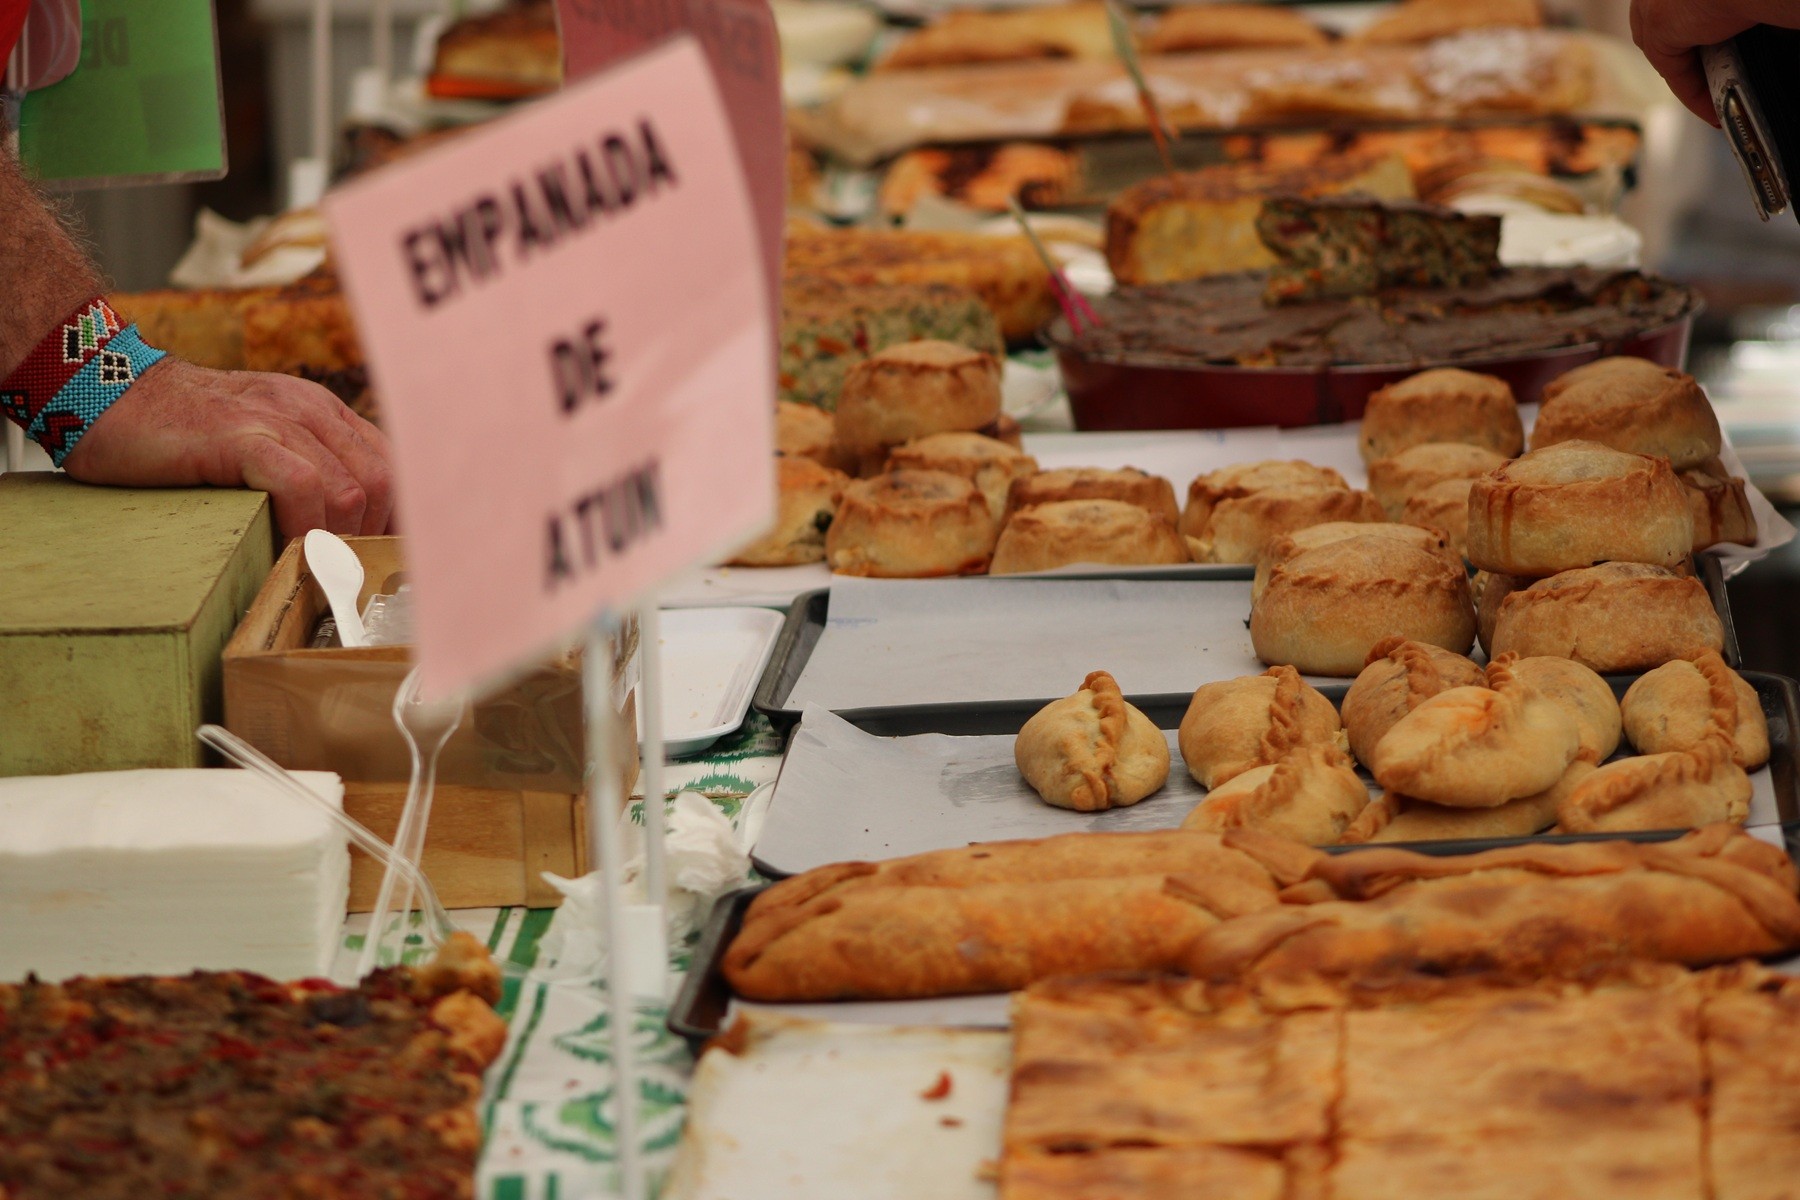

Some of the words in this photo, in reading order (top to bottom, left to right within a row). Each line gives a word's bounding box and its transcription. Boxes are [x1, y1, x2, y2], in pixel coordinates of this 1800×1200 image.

[401, 117, 677, 307] EMPANADA
[550, 320, 612, 415] DE
[545, 458, 662, 588] ATUN
